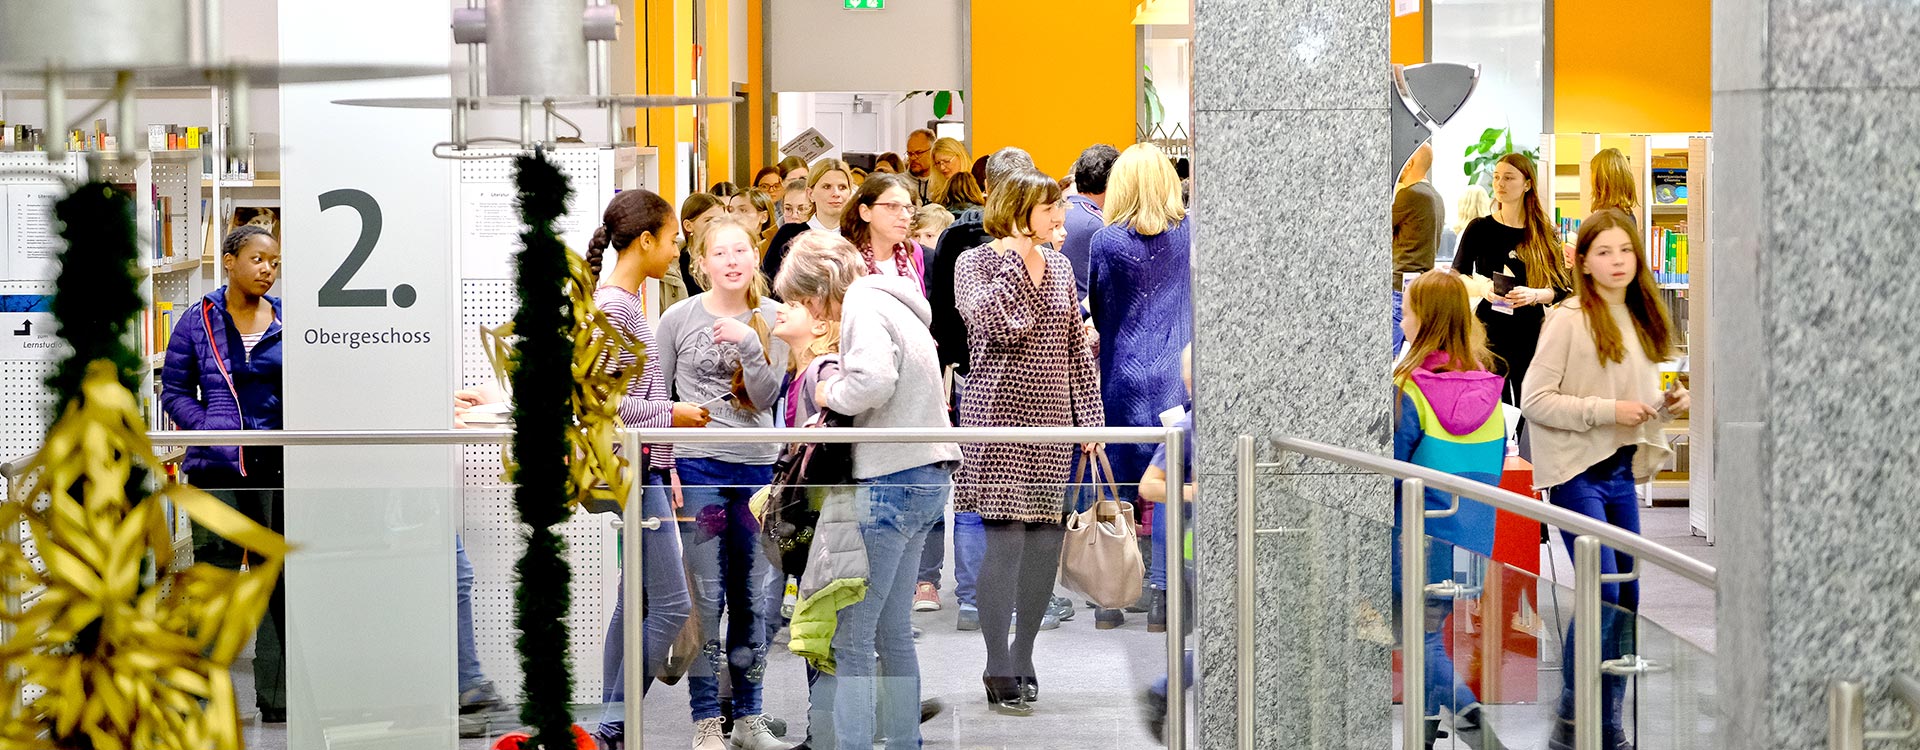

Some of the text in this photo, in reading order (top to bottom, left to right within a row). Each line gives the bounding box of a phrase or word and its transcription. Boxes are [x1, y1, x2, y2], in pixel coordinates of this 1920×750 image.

[318, 188, 417, 308] 2.
[23, 341, 63, 349] Lernstudio
[304, 327, 431, 349] Obergeschoss
